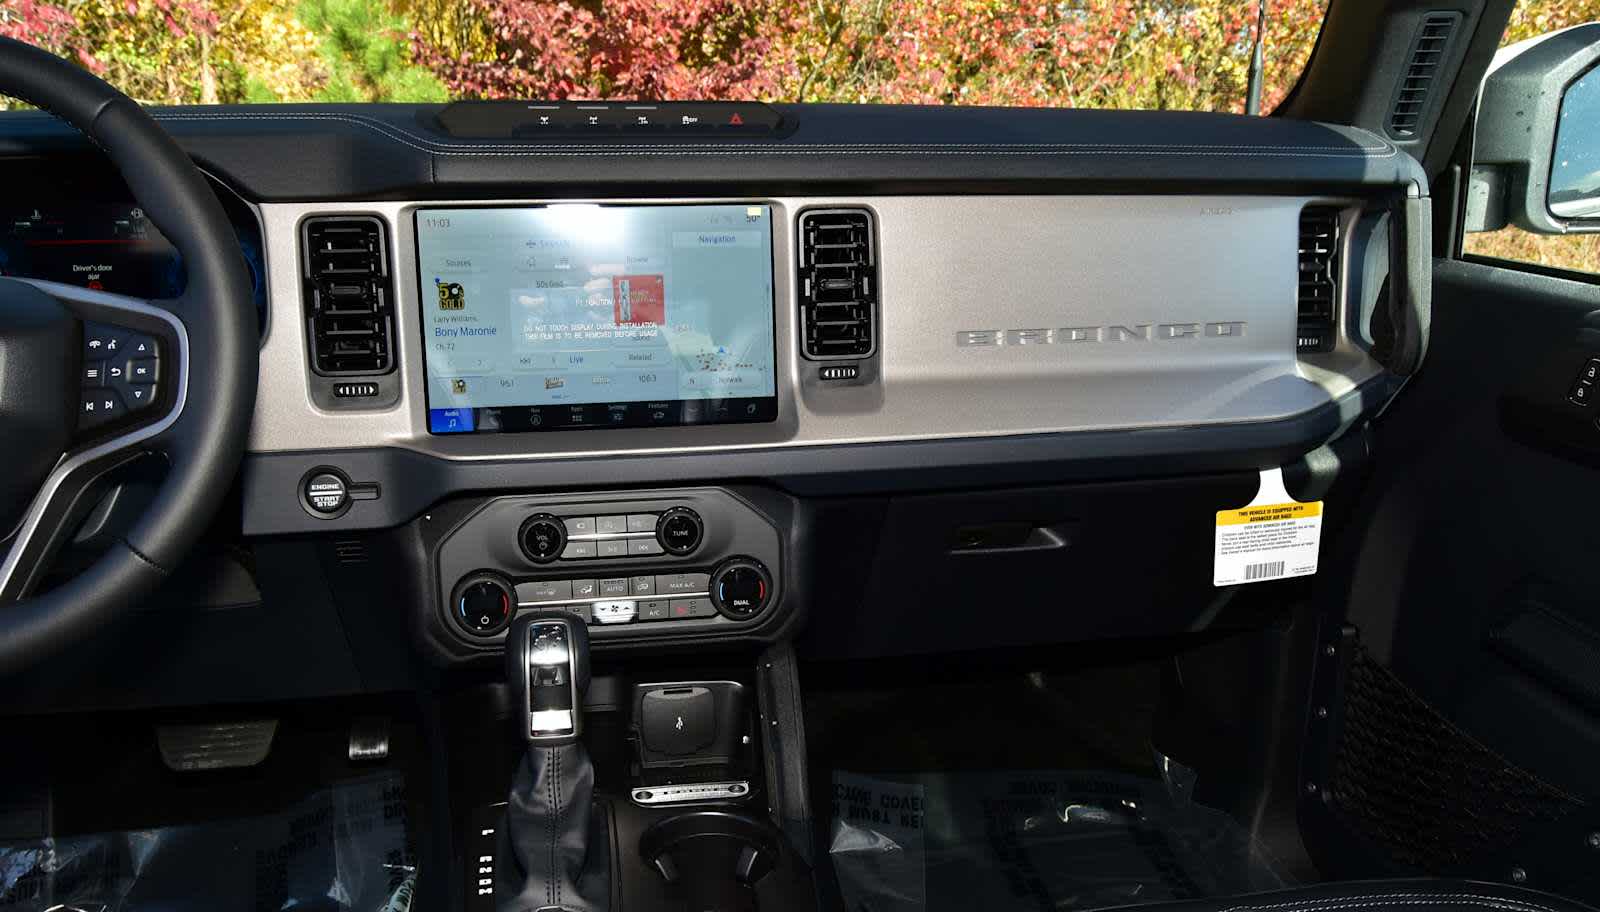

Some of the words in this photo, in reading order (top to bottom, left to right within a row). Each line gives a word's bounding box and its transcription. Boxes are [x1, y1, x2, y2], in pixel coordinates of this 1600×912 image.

[699, 234, 736, 244] Navigation
[72, 264, 97, 272] Driver's
[435, 327, 458, 338] Bony
[460, 326, 497, 336] Maronie
[956, 321, 1247, 347] BRONCO
[569, 356, 583, 364] Live
[136, 367, 146, 375] OK
[311, 483, 340, 491] ENGINE
